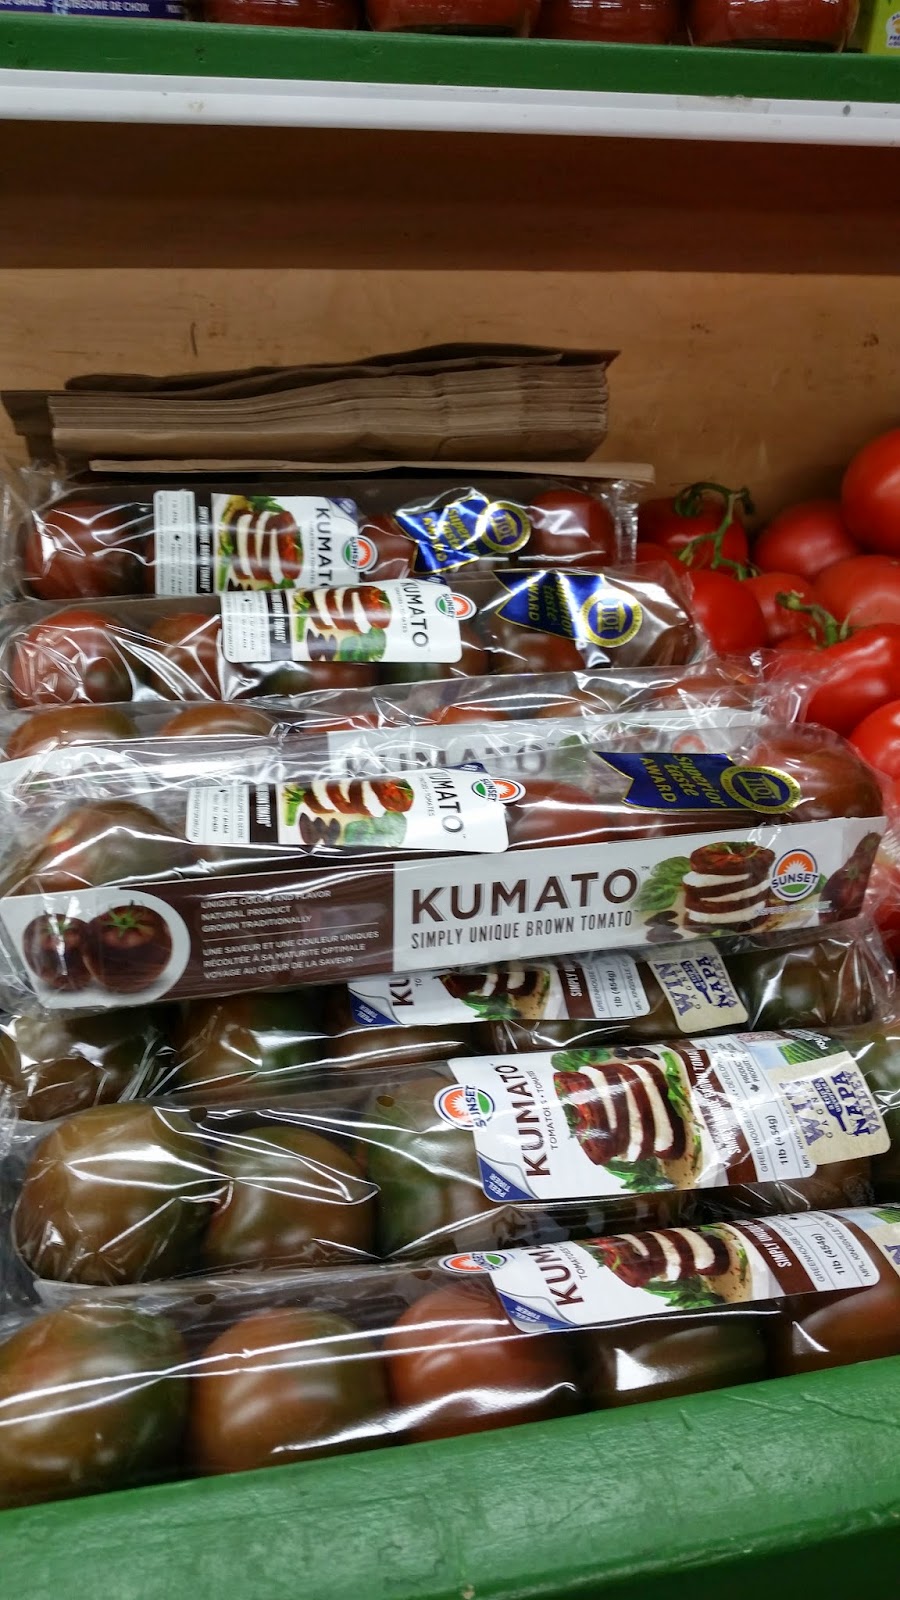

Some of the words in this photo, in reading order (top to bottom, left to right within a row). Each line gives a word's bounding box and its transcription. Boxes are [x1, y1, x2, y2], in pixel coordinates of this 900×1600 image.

[315, 507, 332, 586] KUMAT
[401, 581, 429, 648] KUMATO
[480, 778, 497, 802] SUNSET
[640, 757, 677, 803] AWARD
[664, 764, 700, 797] taste
[673, 754, 728, 807] Superior
[771, 871, 820, 889] SUNSET
[200, 899, 239, 909] UNIQUE
[201, 910, 246, 921] NATURAL
[247, 905, 292, 917] PRODUCT
[201, 922, 240, 933] GROWN
[240, 915, 312, 929] TRADITIONALLY
[411, 926, 464, 950] SIMPLY
[469, 921, 520, 944] UNIQUE
[526, 915, 575, 937] BROWN
[580, 909, 633, 931] TOMATO
[202, 948, 224, 957] UNE
[225, 943, 262, 954] SAVEUR
[262, 941, 274, 950] ET
[276, 939, 295, 949] UNE
[296, 935, 339, 946] COULEUR
[340, 930, 380, 942] UNIQUES
[262, 952, 274, 962] SA
[321, 943, 367, 955] OPTIMALE
[204, 968, 242, 980] VOYAGE
[243, 965, 257, 975] AU
[258, 962, 290, 974] COEUR
[291, 961, 304, 970] DE
[305, 959, 318, 968] LA
[319, 955, 355, 967] SAVEUR
[565, 972, 583, 997] SIMPLY
[607, 969, 621, 994] (454g)
[653, 962, 694, 1016] WIN
[695, 956, 728, 1008] NAPA
[830, 1070, 871, 1137] NAPA
[845, 1071, 882, 1135] VALLEY
[494, 1064, 551, 1177] KUMATO
[765, 1242, 792, 1268] SIMPLY
[812, 1232, 837, 1258] (454g)
[789, 1236, 826, 1283] GREENHOUSE
[832, 1260, 846, 1276] 1lb
